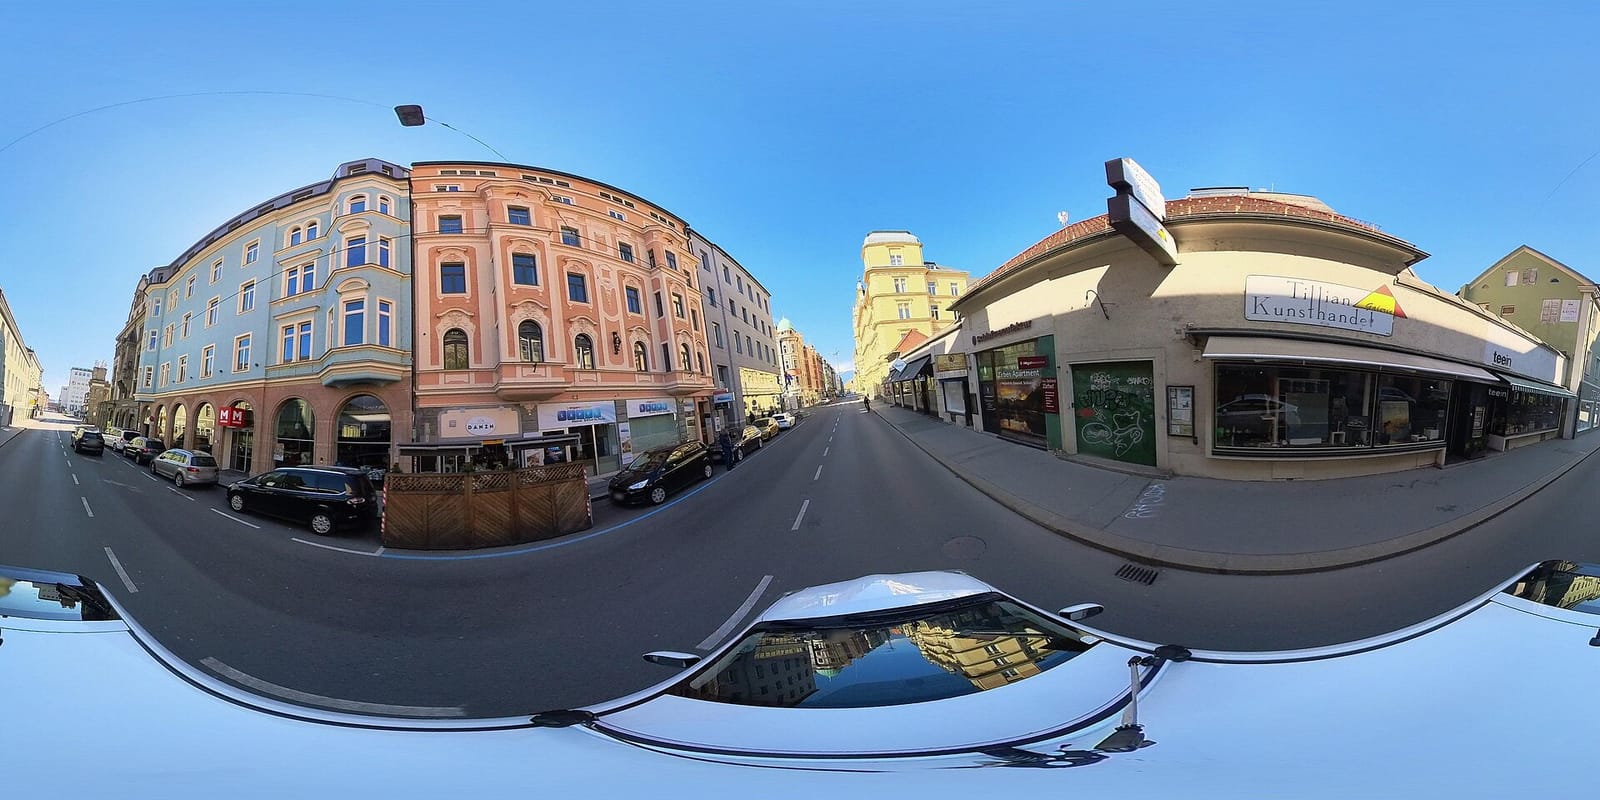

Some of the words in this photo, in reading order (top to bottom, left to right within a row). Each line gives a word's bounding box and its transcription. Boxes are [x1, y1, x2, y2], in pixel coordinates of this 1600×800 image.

[1287, 281, 1350, 305] Tillian
[1251, 295, 1374, 328] Kunsthandel
[220, 410, 229, 420] M
[232, 411, 242, 421] M
